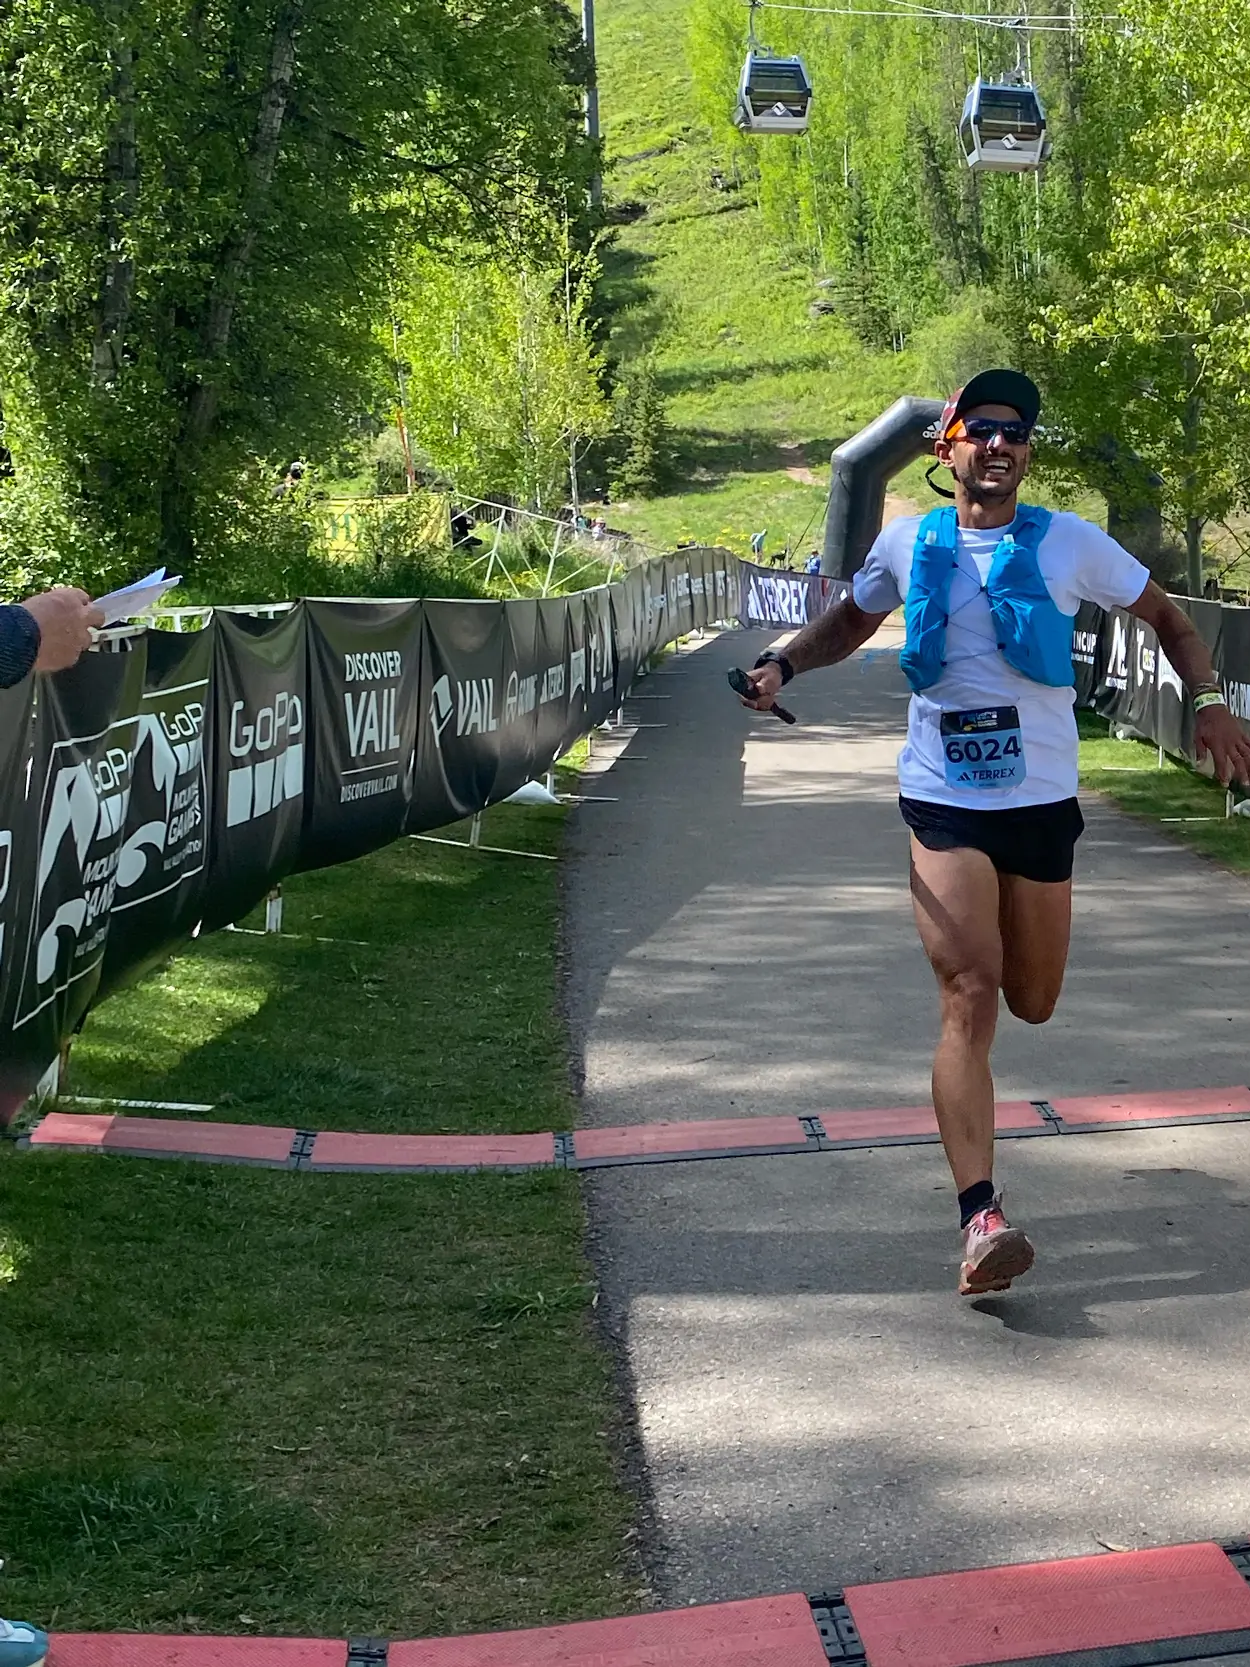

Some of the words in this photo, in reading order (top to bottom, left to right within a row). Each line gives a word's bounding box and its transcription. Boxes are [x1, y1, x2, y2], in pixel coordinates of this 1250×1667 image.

[344, 650, 402, 682] DISCOVER
[344, 687, 401, 757] VAIL
[457, 677, 498, 737] VAIL
[945, 735, 1022, 764] 6024
[971, 767, 1016, 781] TERREX
